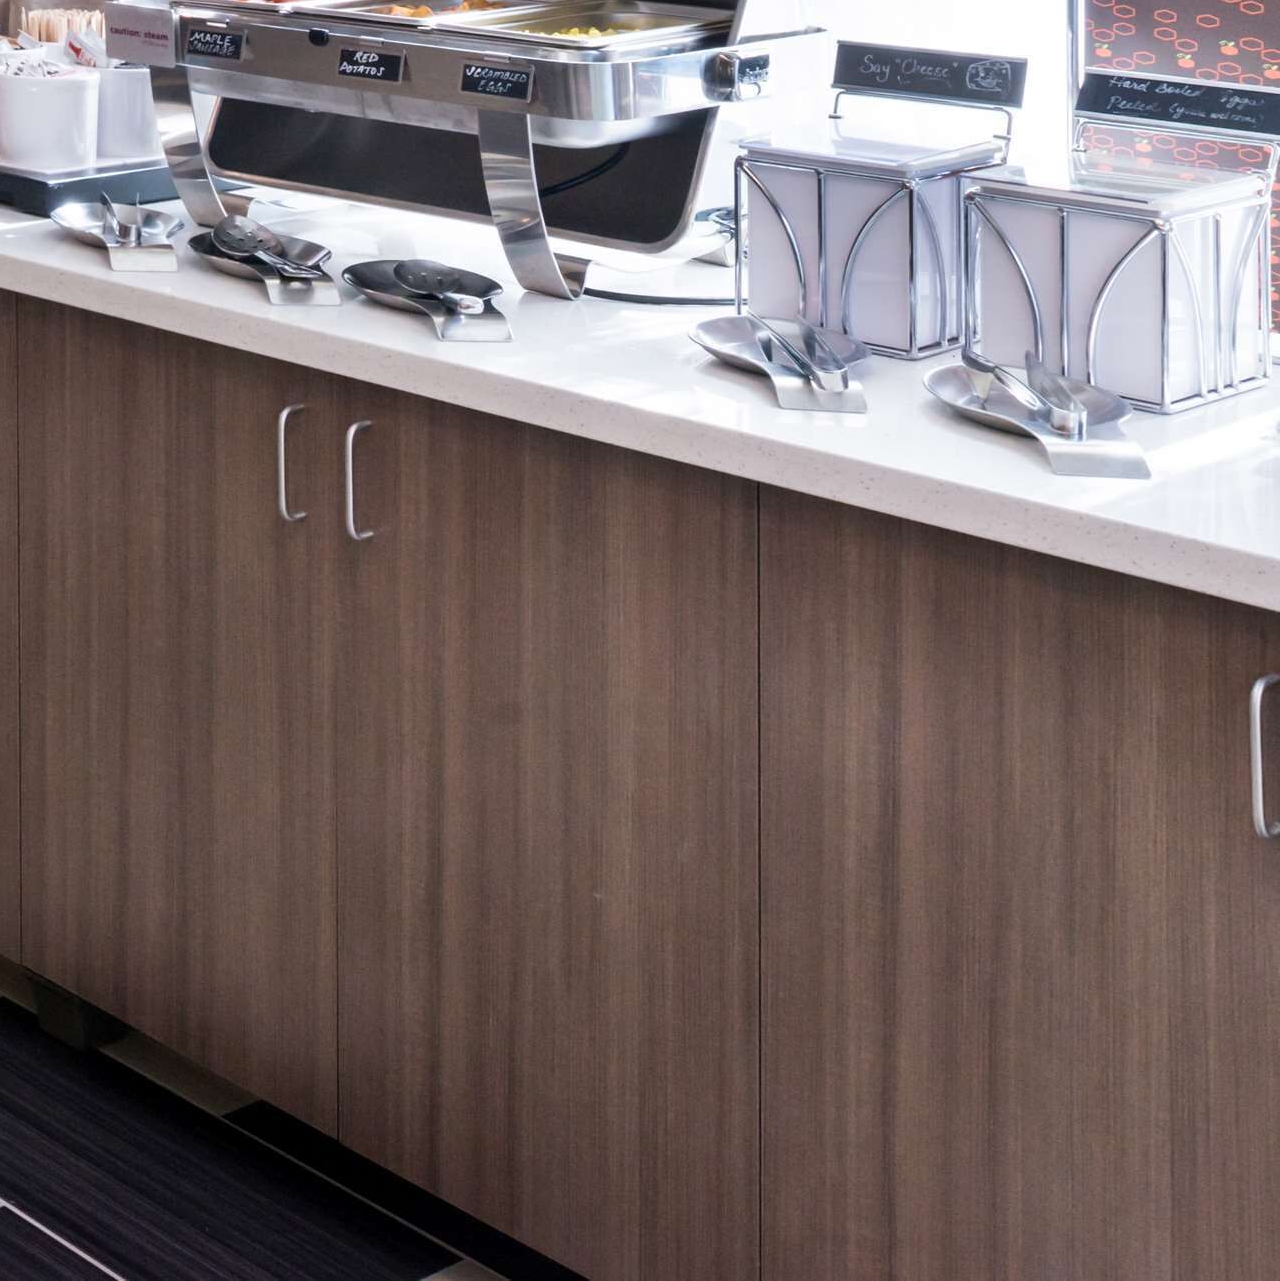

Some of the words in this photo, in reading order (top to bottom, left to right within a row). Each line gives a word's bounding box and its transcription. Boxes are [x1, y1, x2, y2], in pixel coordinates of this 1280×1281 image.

[144, 30, 170, 41] steam
[189, 31, 233, 50] MAPLE
[353, 51, 379, 64] RED
[860, 54, 891, 83] Say
